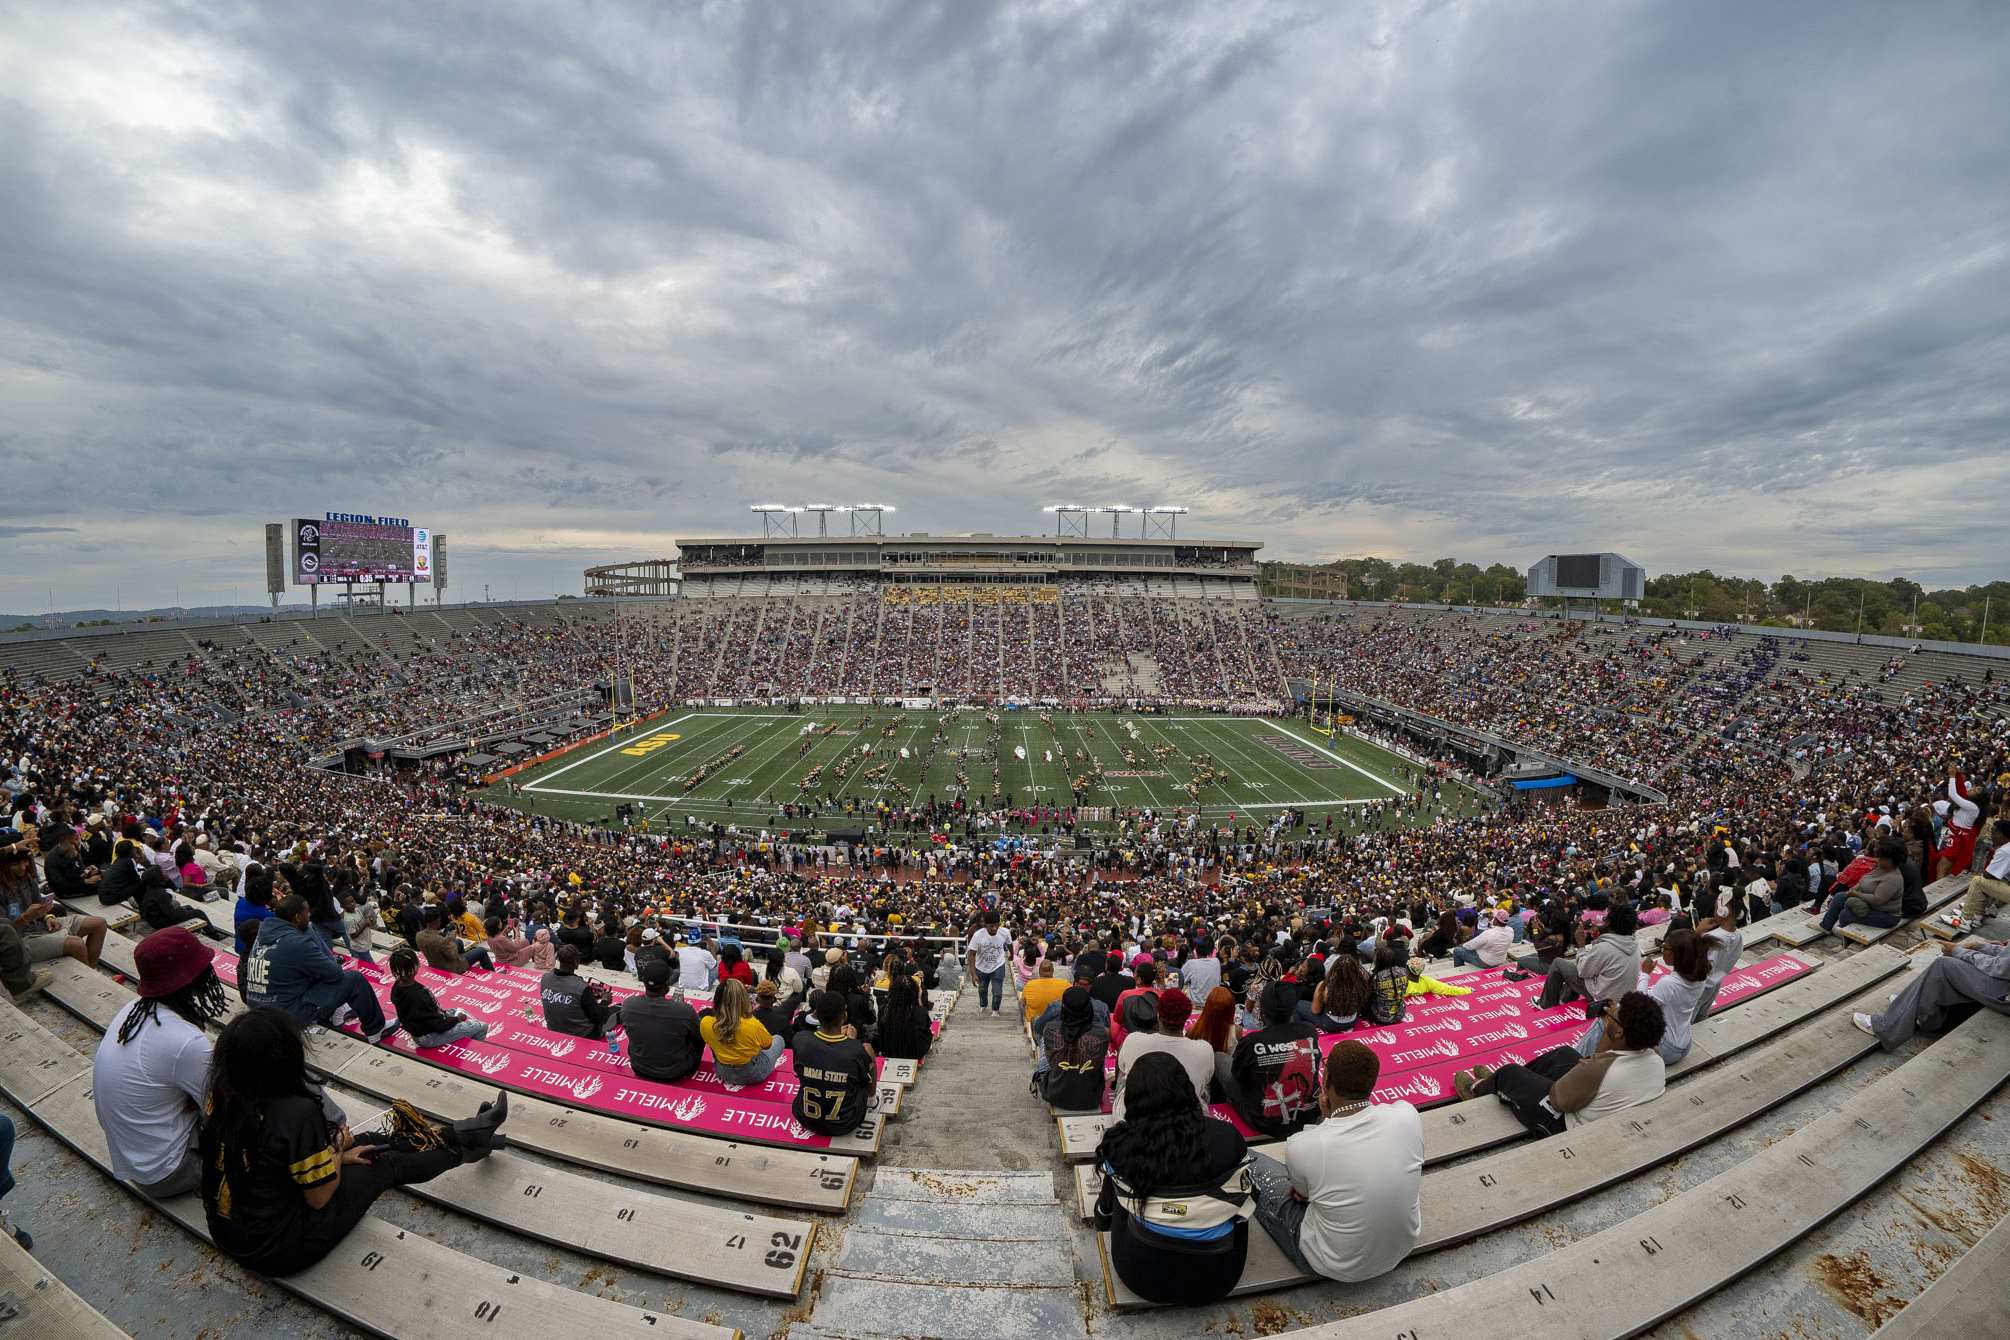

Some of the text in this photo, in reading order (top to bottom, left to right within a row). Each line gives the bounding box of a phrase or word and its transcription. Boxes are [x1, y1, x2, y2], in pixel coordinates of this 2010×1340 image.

[326, 512, 409, 528] LEGION FIELD
[620, 733, 681, 756] ASU
[1760, 965, 1787, 979] MIELLE
[1718, 982, 1746, 996] MIELLE
[451, 994, 487, 1008] MIELLE
[1475, 991, 1510, 1004] MIELLE
[1420, 1003, 1457, 1016] MIELLE
[1467, 1010, 1505, 1023] MIELLE
[1532, 1013, 1572, 1029] MIELLE
[1404, 1024, 1446, 1037] MIELLE
[1466, 1029, 1511, 1046] MIELLE
[510, 1031, 552, 1049] MIELLE
[1254, 1041, 1298, 1055] G west
[438, 1043, 487, 1066] MIELLE
[1391, 1046, 1439, 1064] MIELLE
[520, 1066, 578, 1089] MIELLE
[824, 1071, 848, 1083] STATE
[763, 1080, 800, 1095] ELLE
[614, 1088, 678, 1113] MIELLE
[802, 1086, 846, 1121] 67
[550, 1118, 568, 1128] 20
[721, 1108, 791, 1131] MIELLE
[855, 1120, 877, 1140] 60
[623, 1138, 639, 1150] 19
[1559, 1147, 1577, 1160] 12
[1479, 1173, 1497, 1188] 13
[524, 1184, 543, 1199] 19
[1725, 1192, 1747, 1210] 12
[616, 1207, 636, 1223] 18
[725, 1234, 747, 1250] 17
[1640, 1236, 1664, 1255] 13
[764, 1231, 801, 1270] 62
[360, 1251, 385, 1272] 19
[1528, 1283, 1556, 1305] 14
